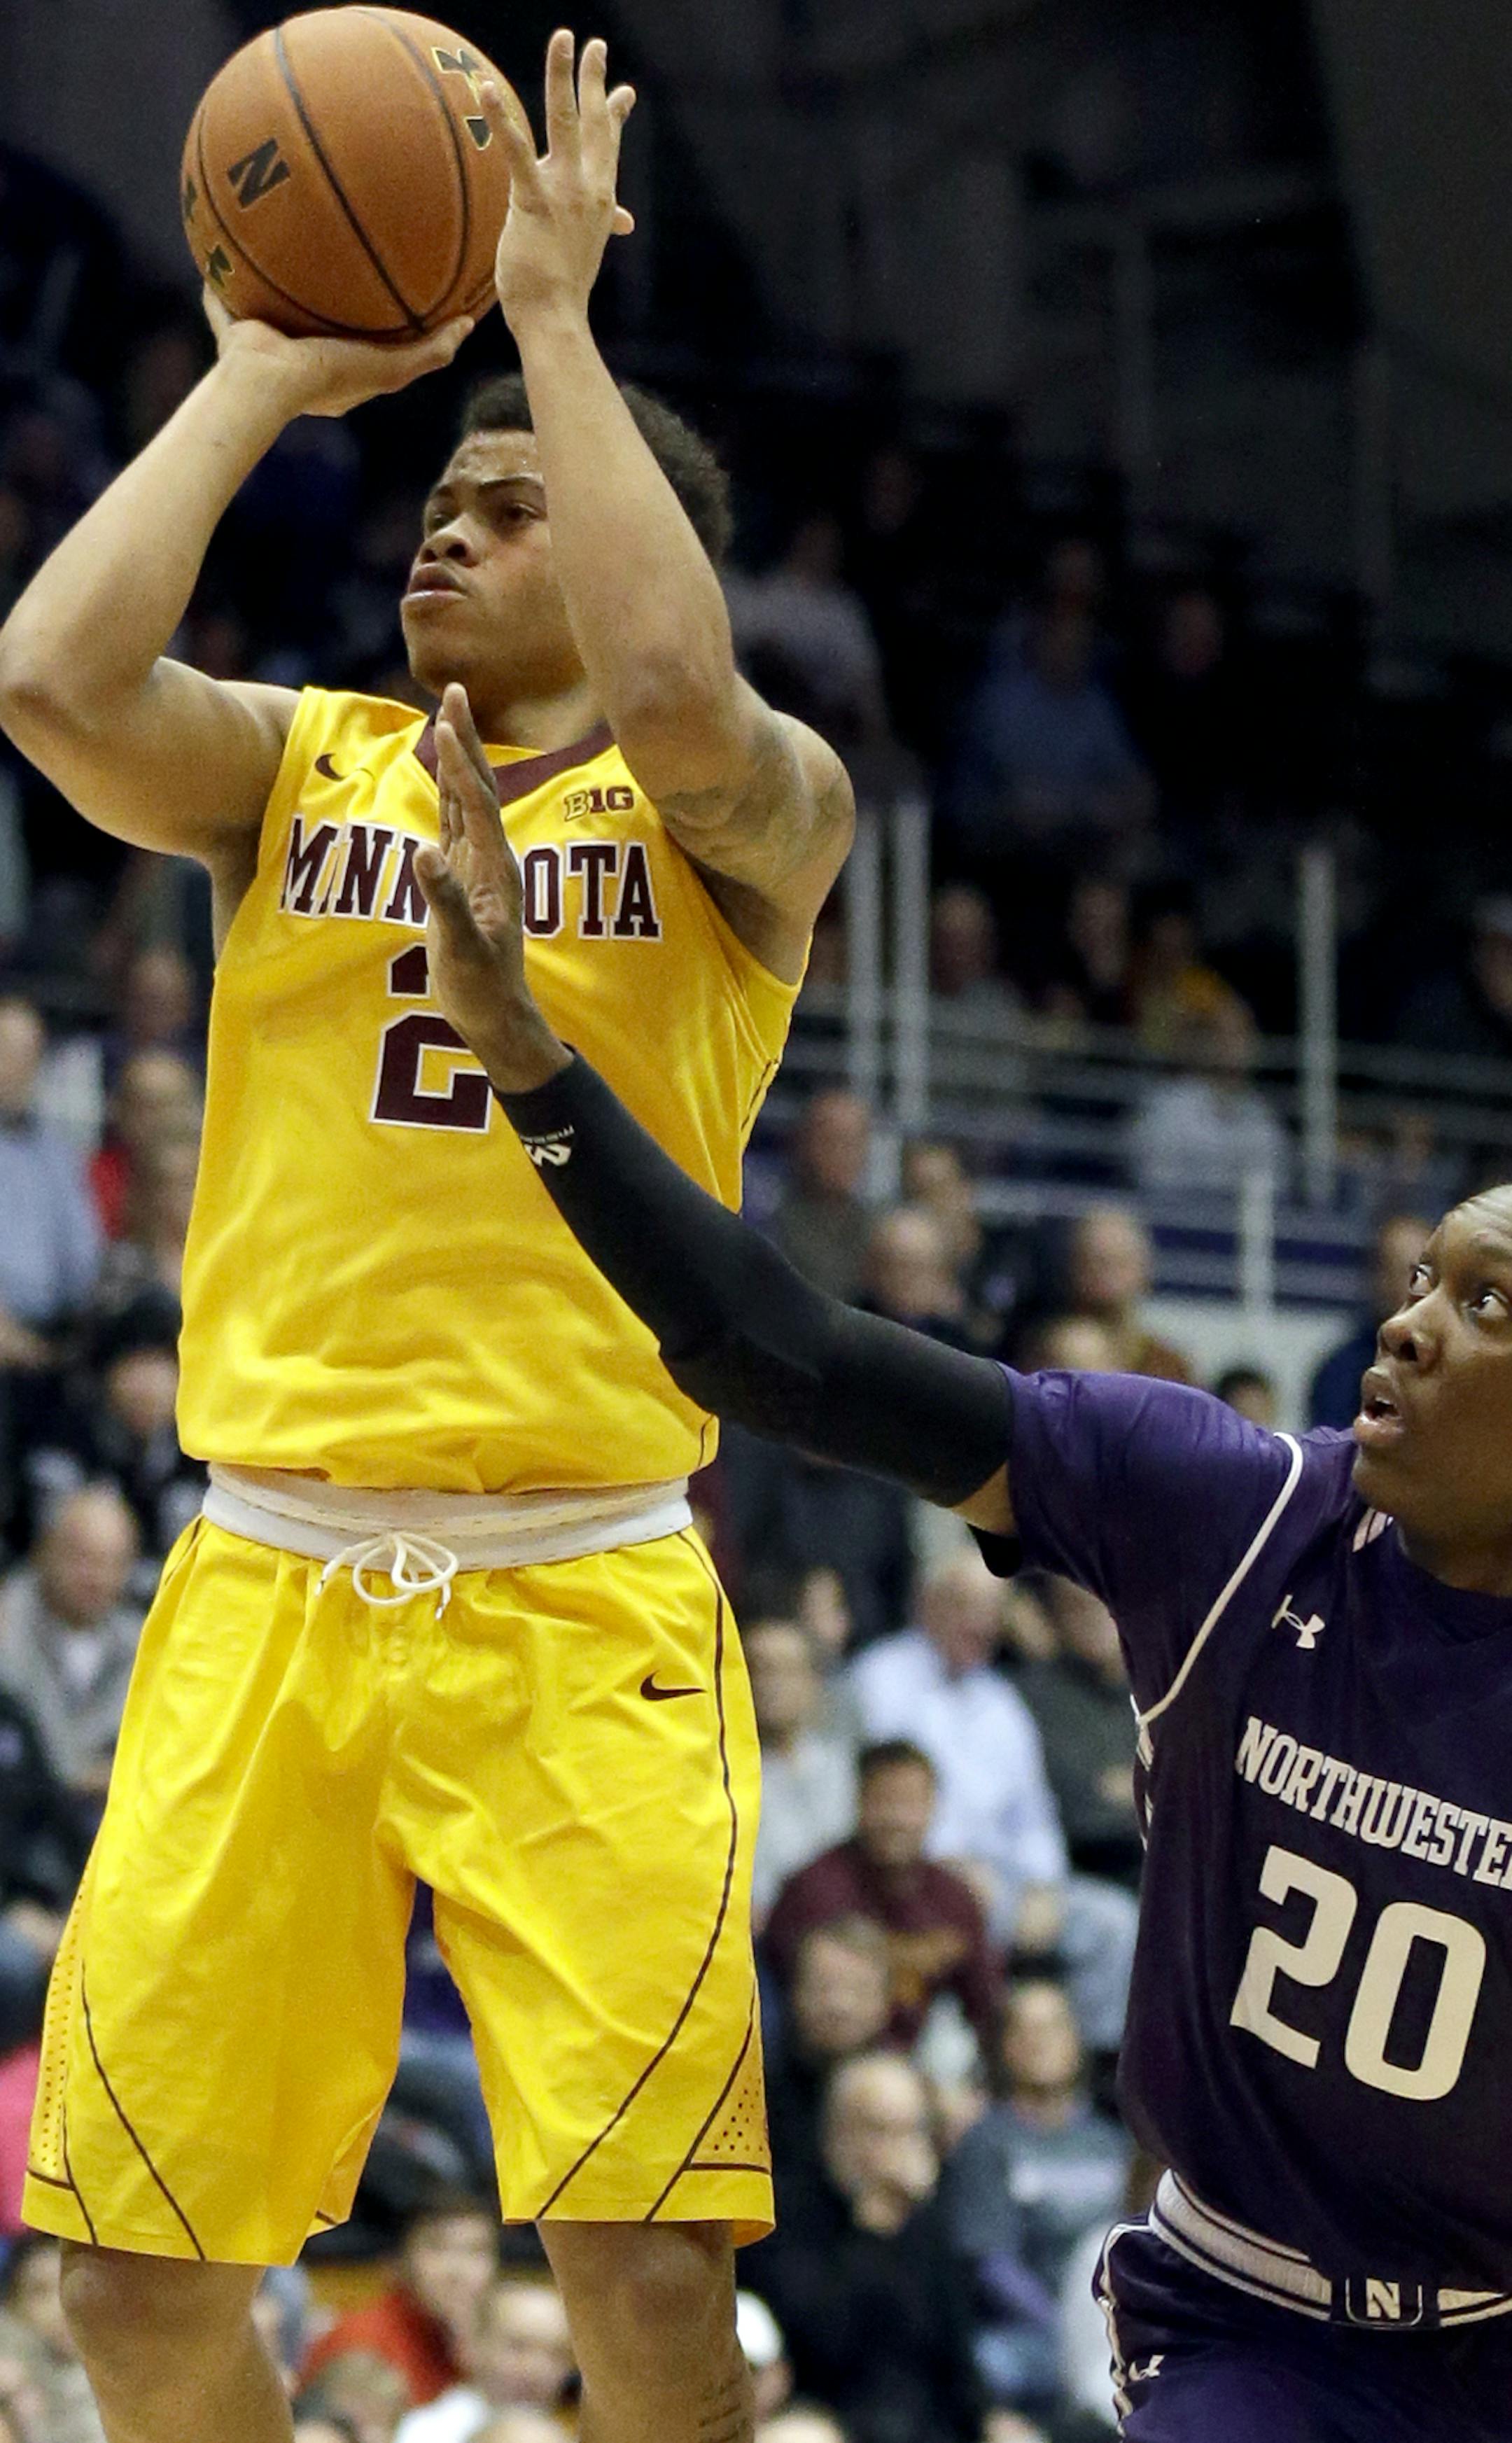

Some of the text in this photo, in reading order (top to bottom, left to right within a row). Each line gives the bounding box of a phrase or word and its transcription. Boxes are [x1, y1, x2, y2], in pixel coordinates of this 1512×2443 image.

[227, 137, 290, 209] N
[278, 813, 662, 941] MNNOTA
[1235, 1716, 1512, 1891] NORTHWESTE
[1230, 1844, 1486, 2101] 20
[1366, 2277, 1400, 2319] N
